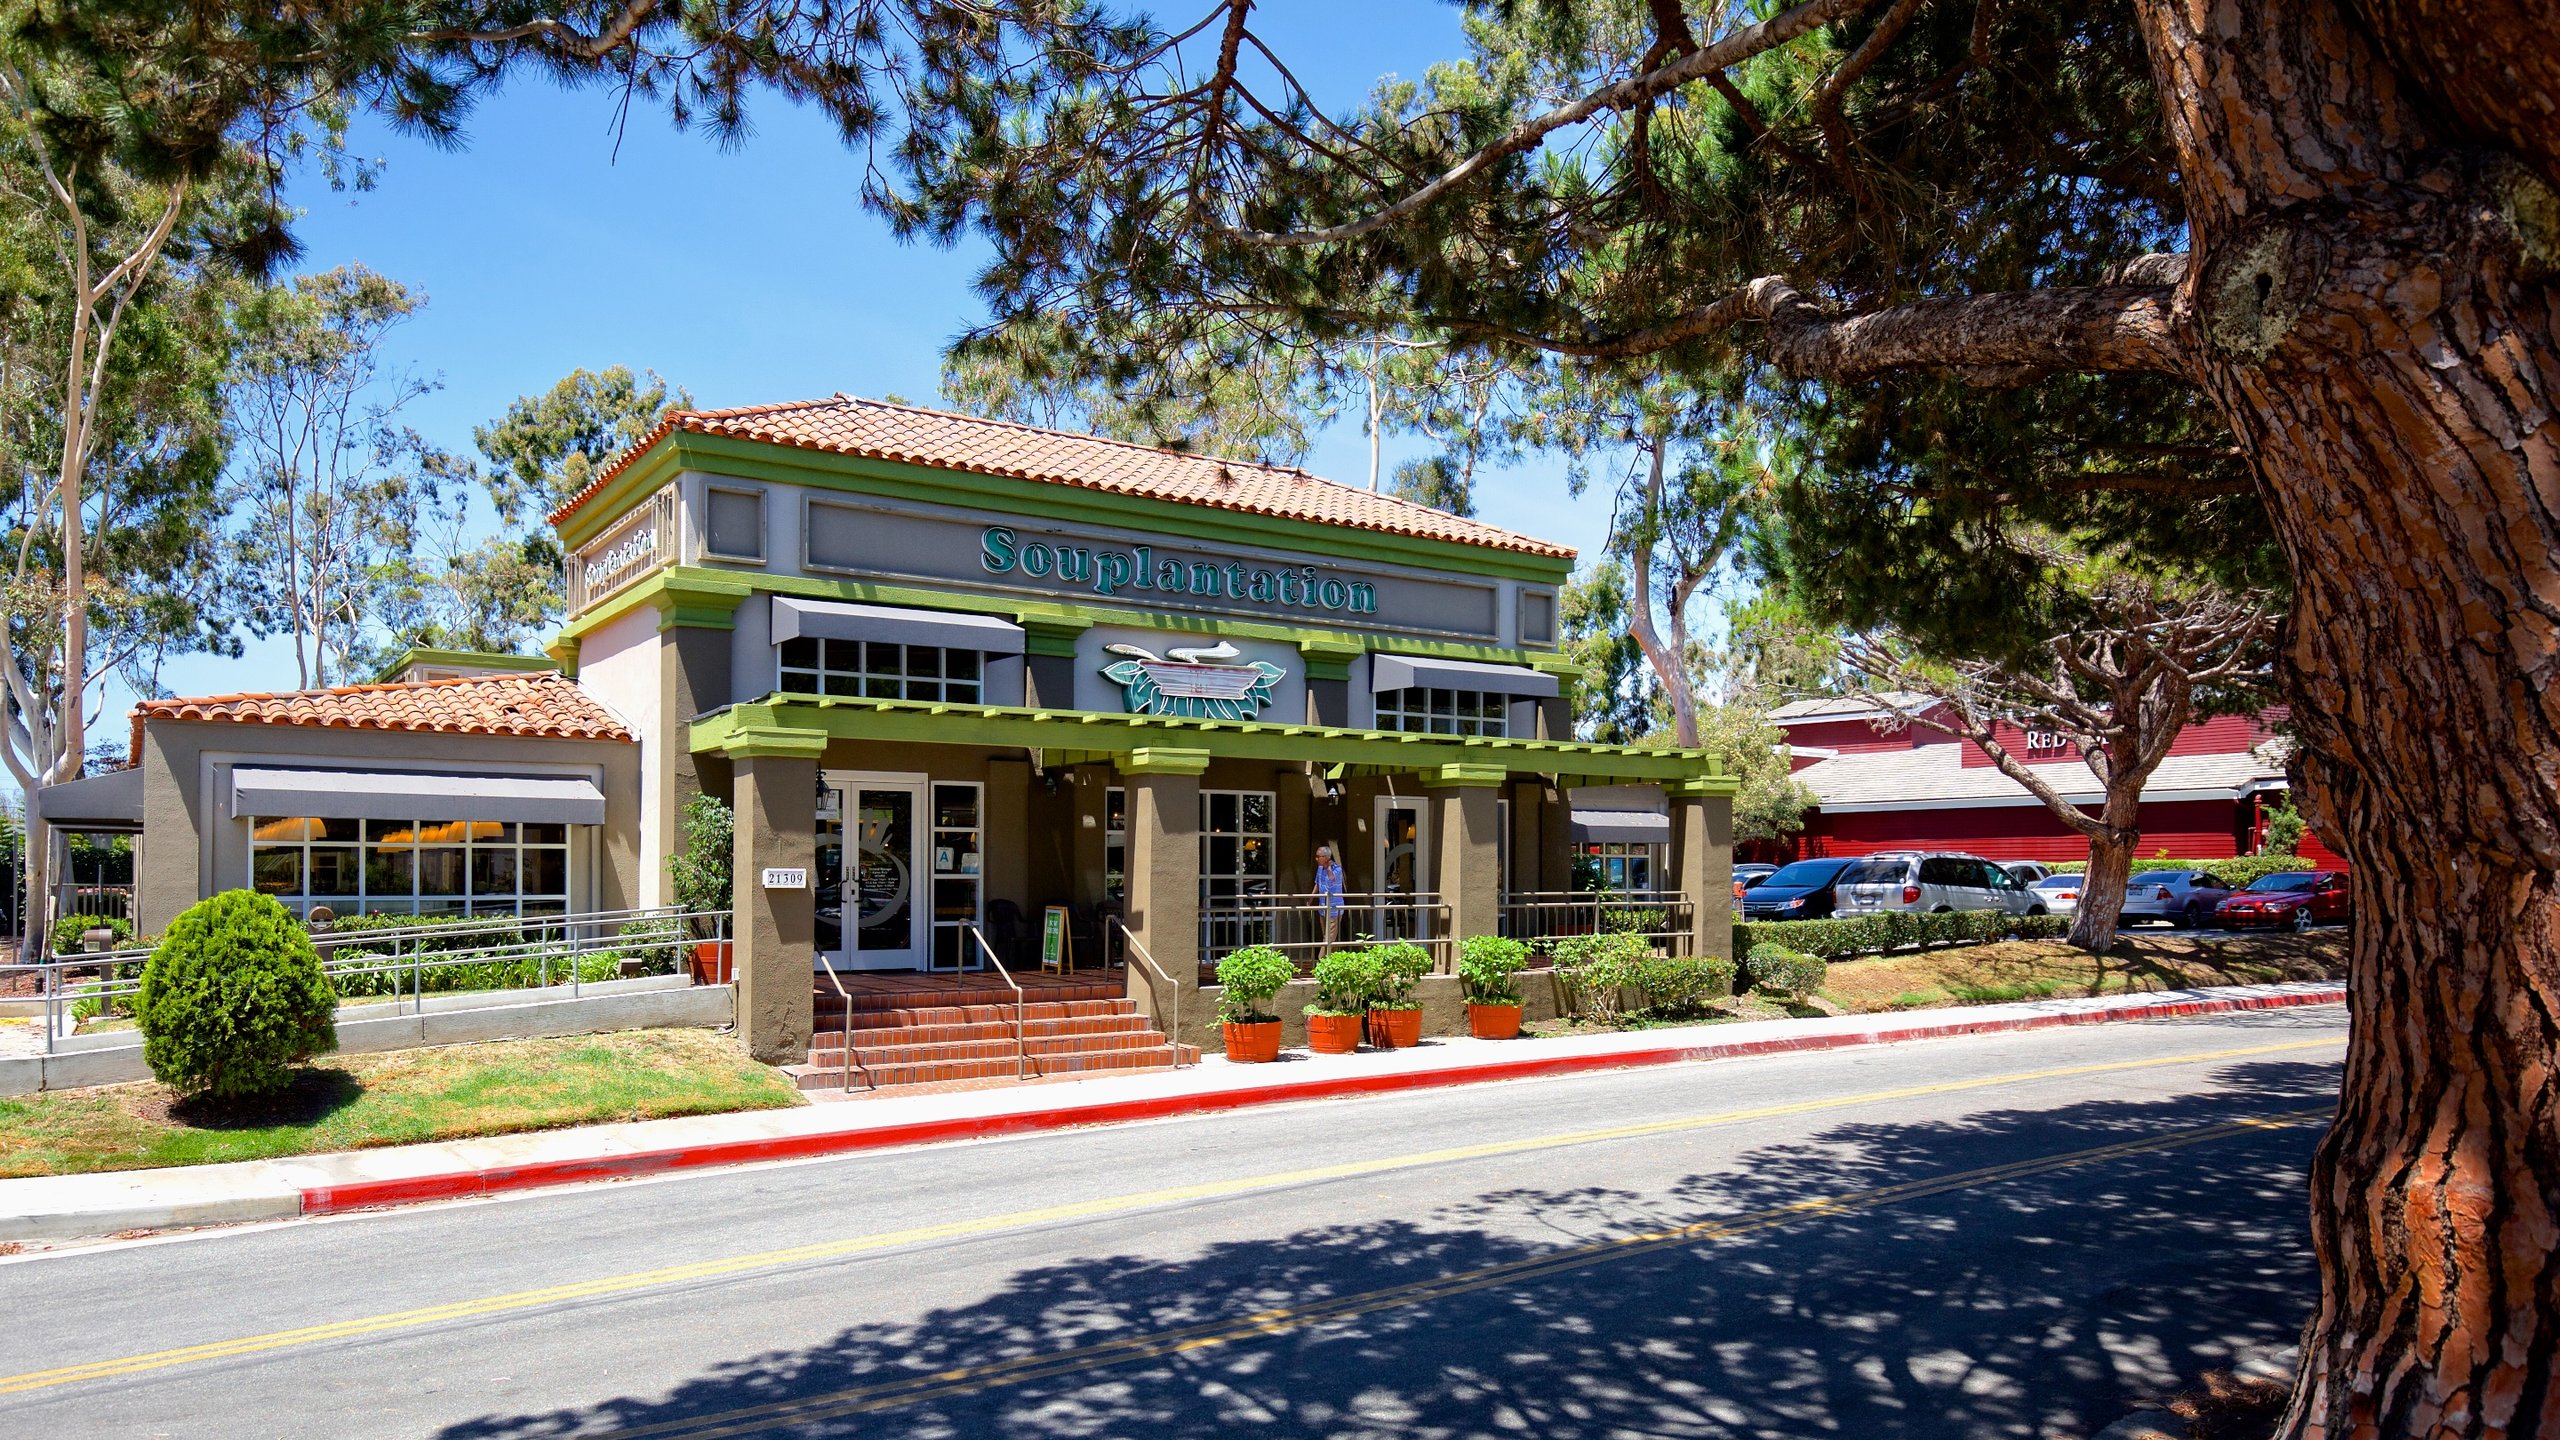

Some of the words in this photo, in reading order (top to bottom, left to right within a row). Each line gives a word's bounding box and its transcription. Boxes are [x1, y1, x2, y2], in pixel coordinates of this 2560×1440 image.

[981, 526, 1378, 613] Souplantation
[940, 851, 949, 862] A
[768, 873, 803, 884] 21309
